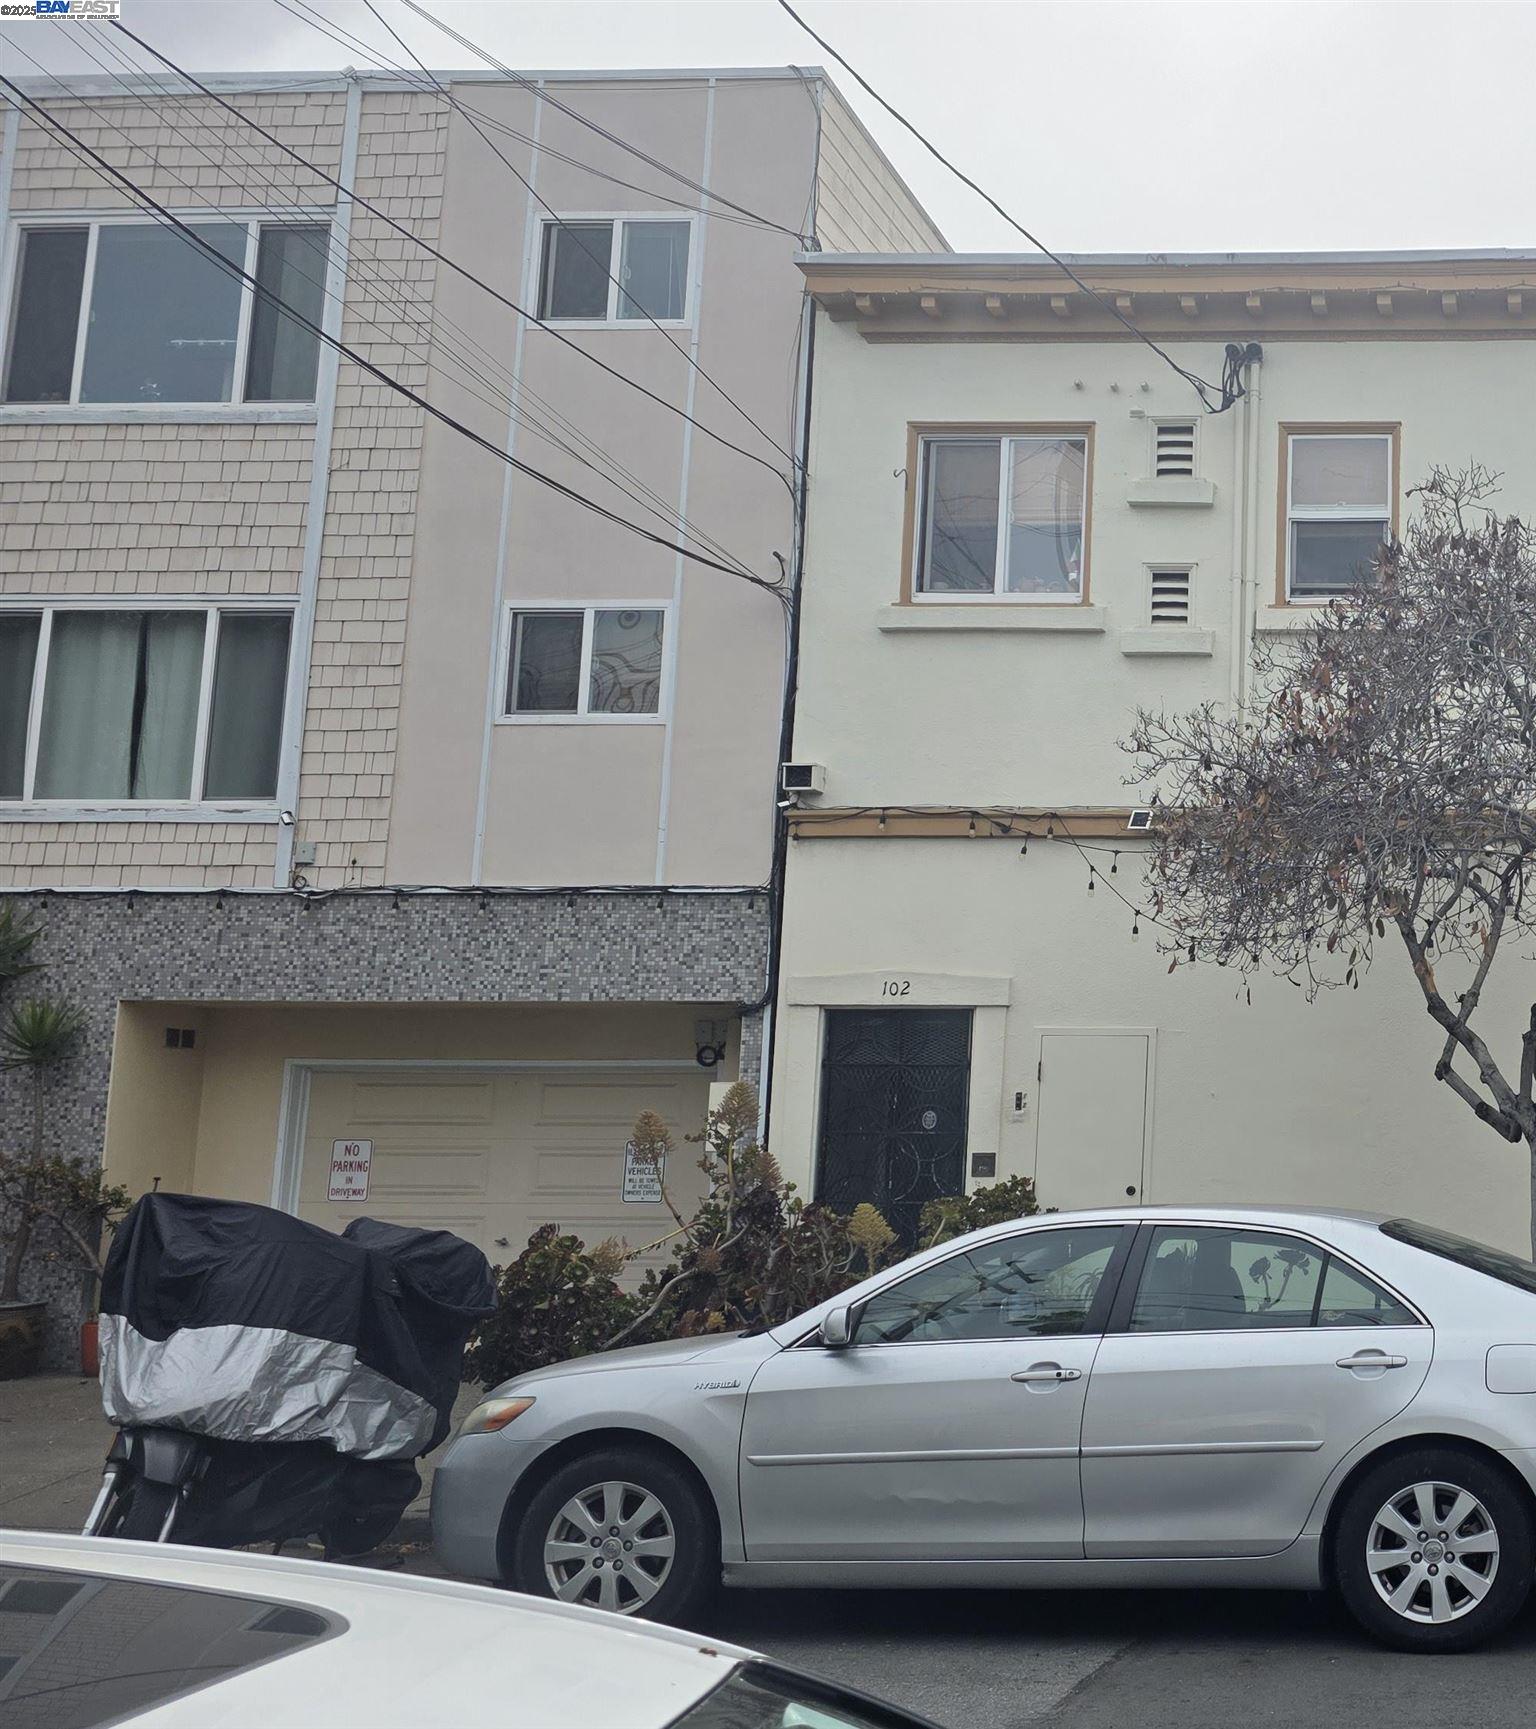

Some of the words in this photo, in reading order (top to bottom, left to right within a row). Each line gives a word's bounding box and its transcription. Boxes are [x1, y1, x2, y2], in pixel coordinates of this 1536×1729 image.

[882, 981, 911, 996] 102
[344, 1144, 360, 1156] NO
[333, 1160, 368, 1172] PARKING
[345, 1176, 353, 1184] IN
[330, 1188, 365, 1196] DRIVEWAY
[694, 1381, 733, 1390] HYBRID
